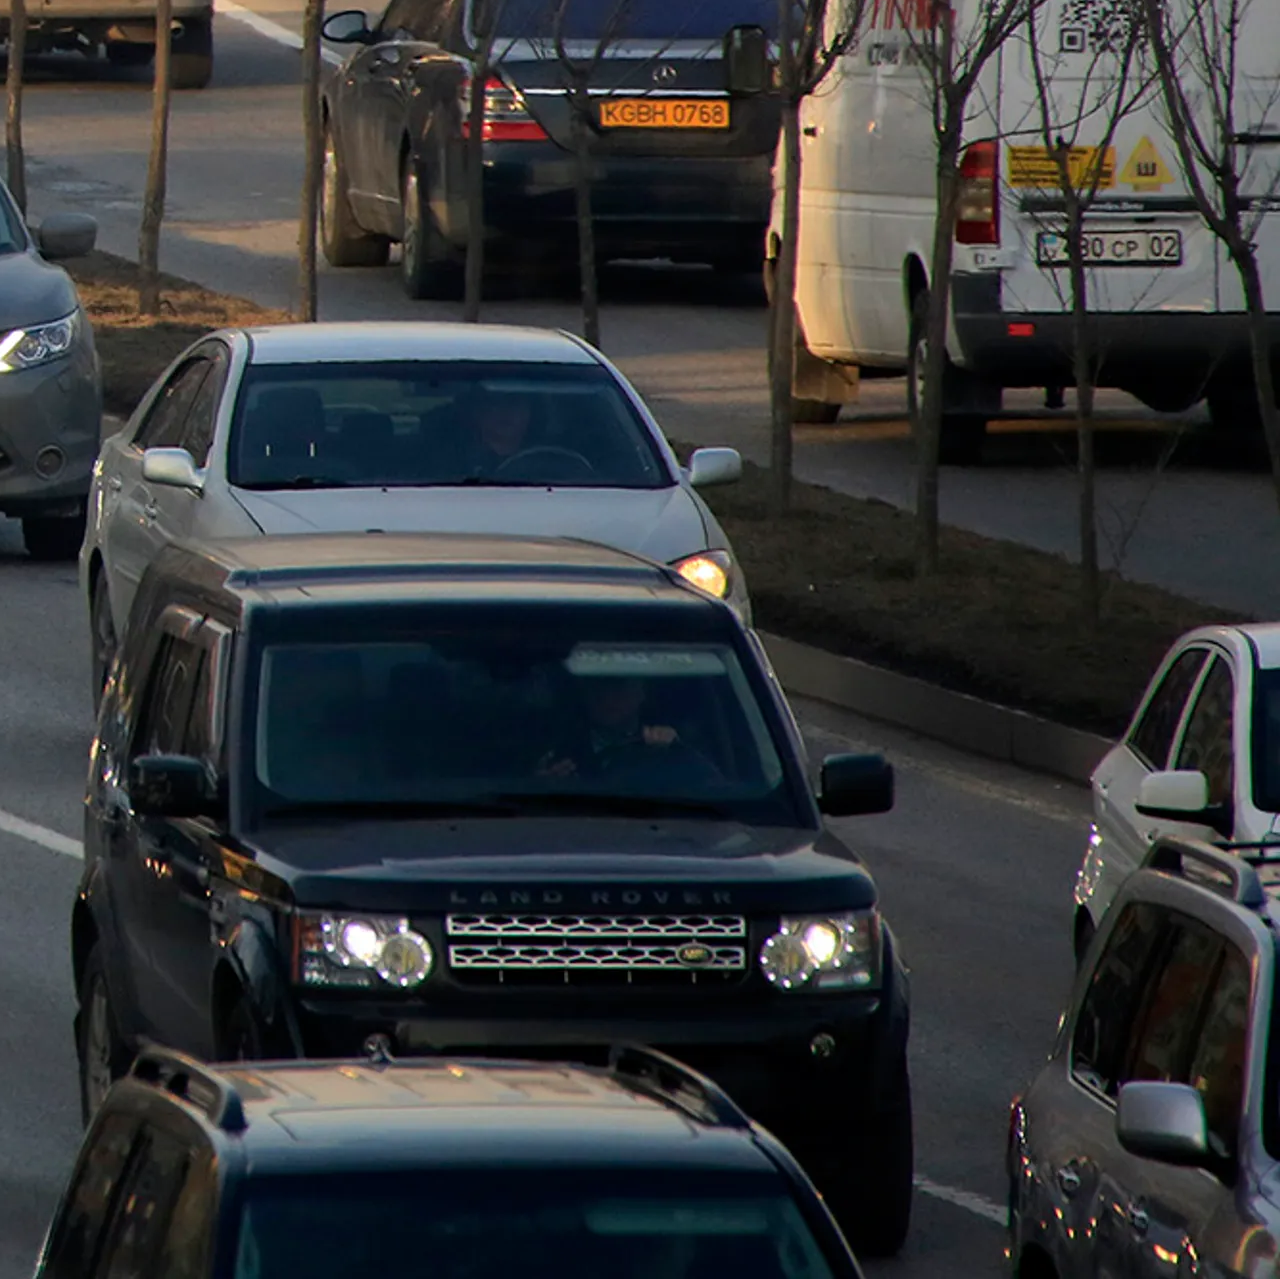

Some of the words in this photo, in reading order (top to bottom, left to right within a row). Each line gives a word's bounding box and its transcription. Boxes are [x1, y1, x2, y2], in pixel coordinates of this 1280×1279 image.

[1150, 236, 1177, 258] 02
[449, 889, 564, 906] LAND
[591, 889, 734, 907] ROVER
